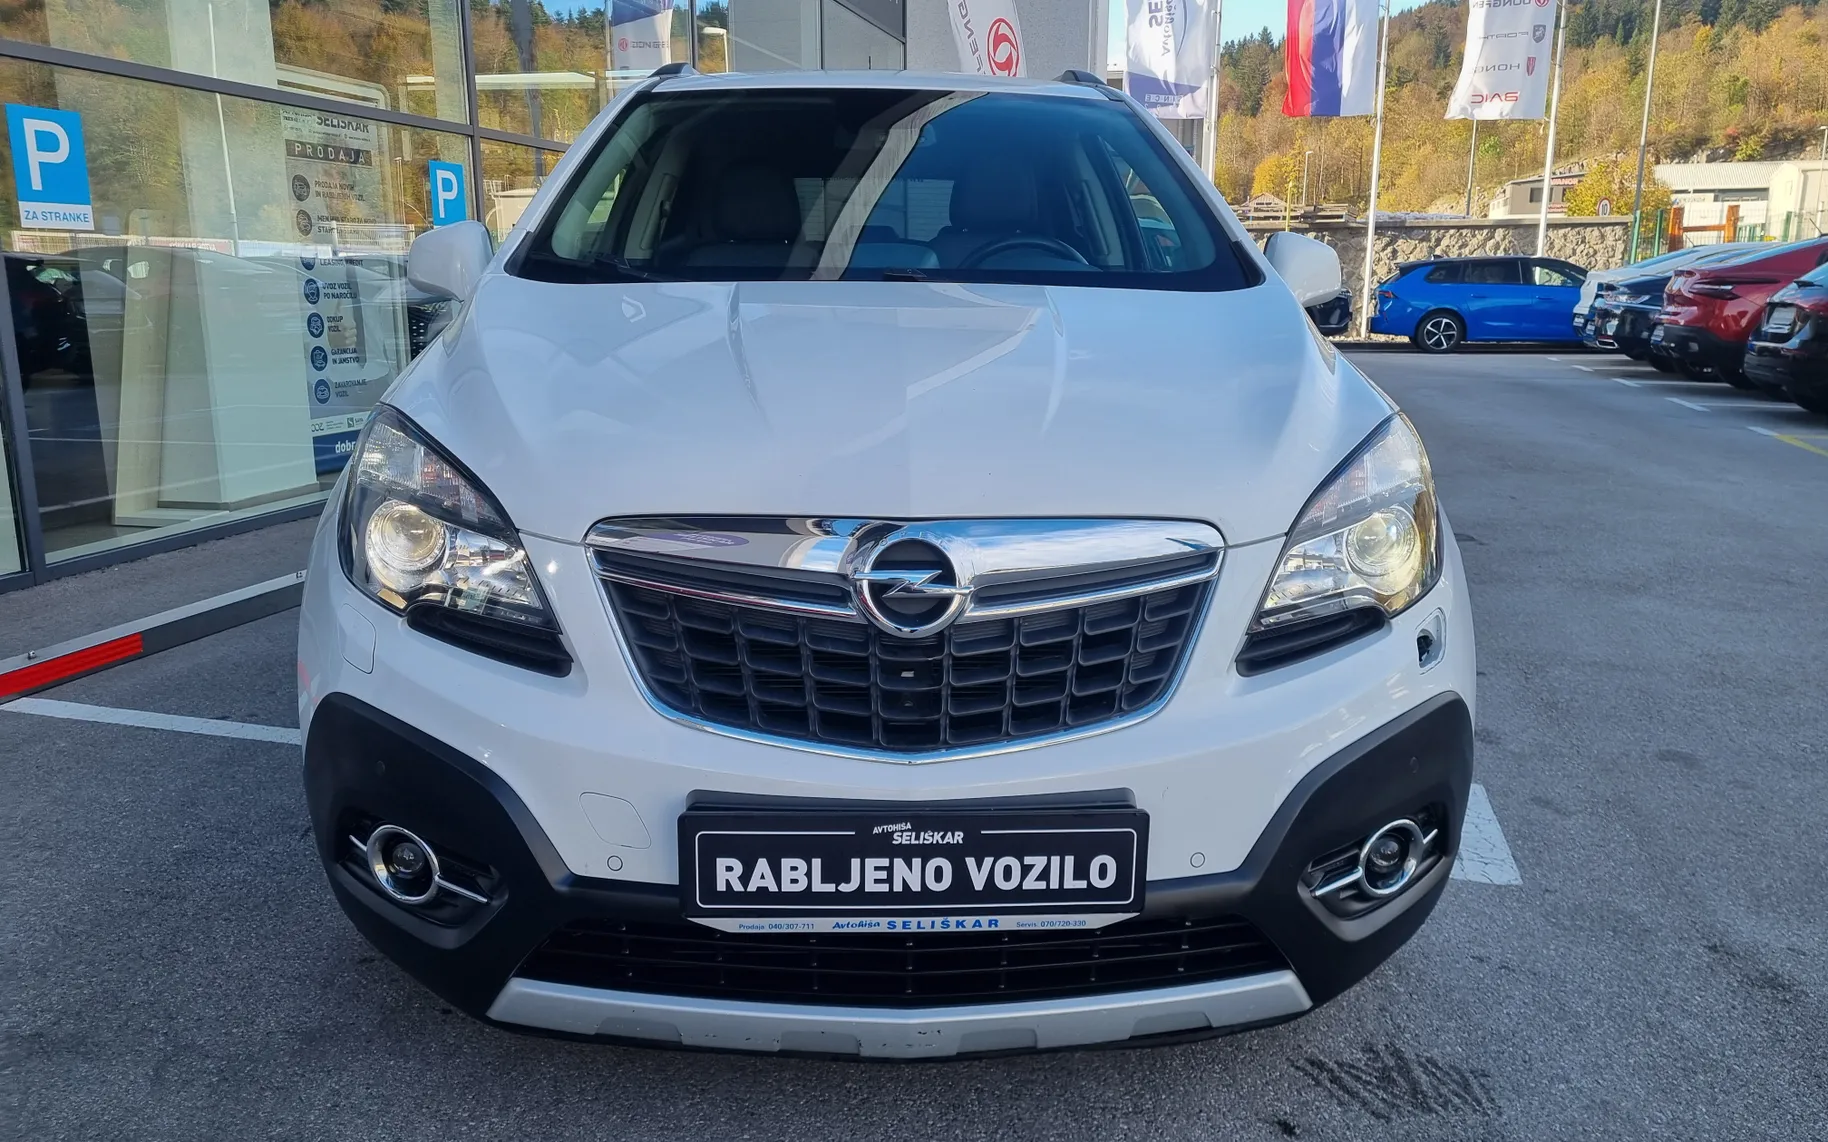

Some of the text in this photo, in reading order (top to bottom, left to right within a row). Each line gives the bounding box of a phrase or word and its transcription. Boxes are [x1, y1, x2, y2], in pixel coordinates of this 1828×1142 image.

[22, 117, 70, 191] P
[294, 143, 366, 164] PRODAJA
[436, 169, 458, 219] P
[24, 209, 90, 223] ZA STRANKE
[892, 830, 964, 845] SELIŠKAR
[716, 854, 1117, 893] RABLJENO VOZILO
[886, 917, 1000, 930] SELIŠKAR
[1040, 919, 1087, 927] 070/720-330
